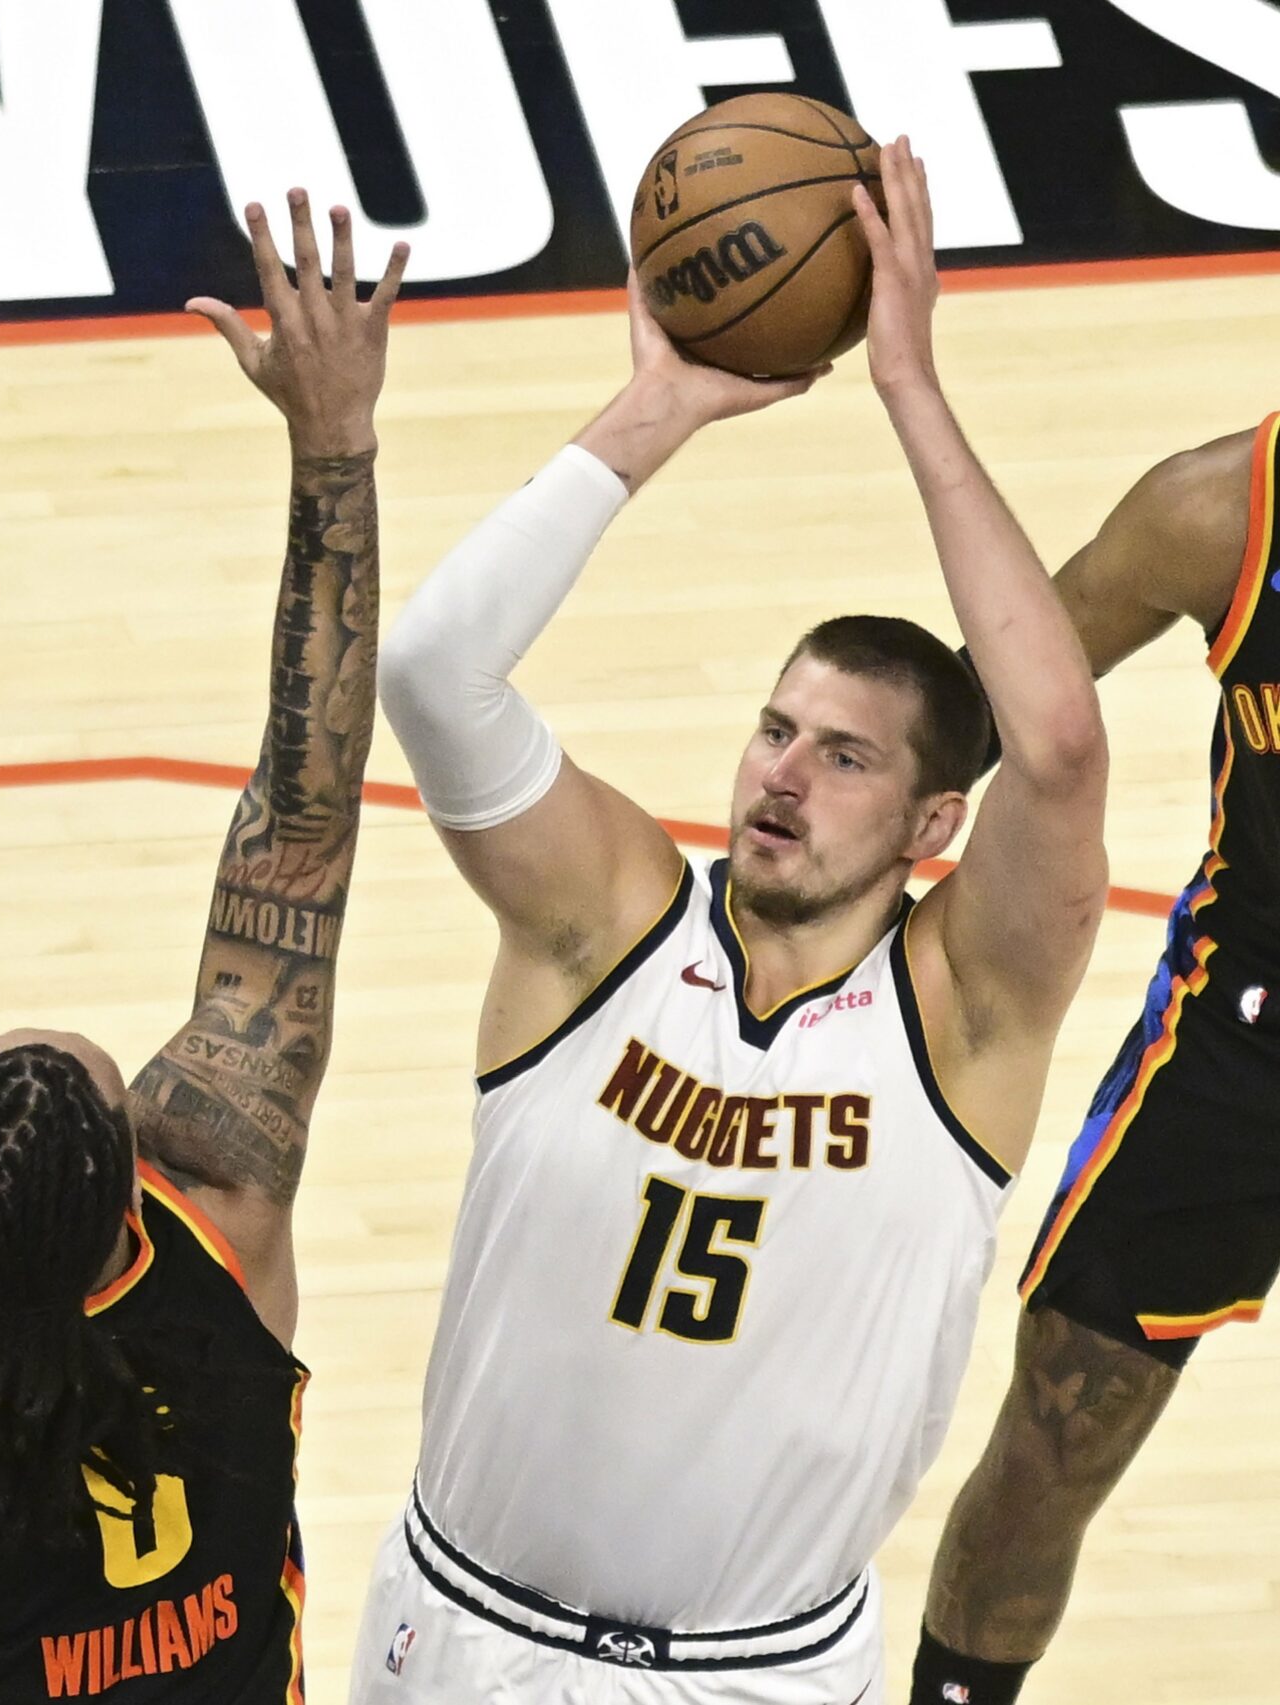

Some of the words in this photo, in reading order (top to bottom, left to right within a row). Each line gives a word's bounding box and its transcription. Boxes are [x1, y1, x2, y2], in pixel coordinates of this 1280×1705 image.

[596, 1035, 873, 1172] NUGGETS
[607, 1173, 770, 1346] 15
[40, 1573, 239, 1698] WILLIAMS
